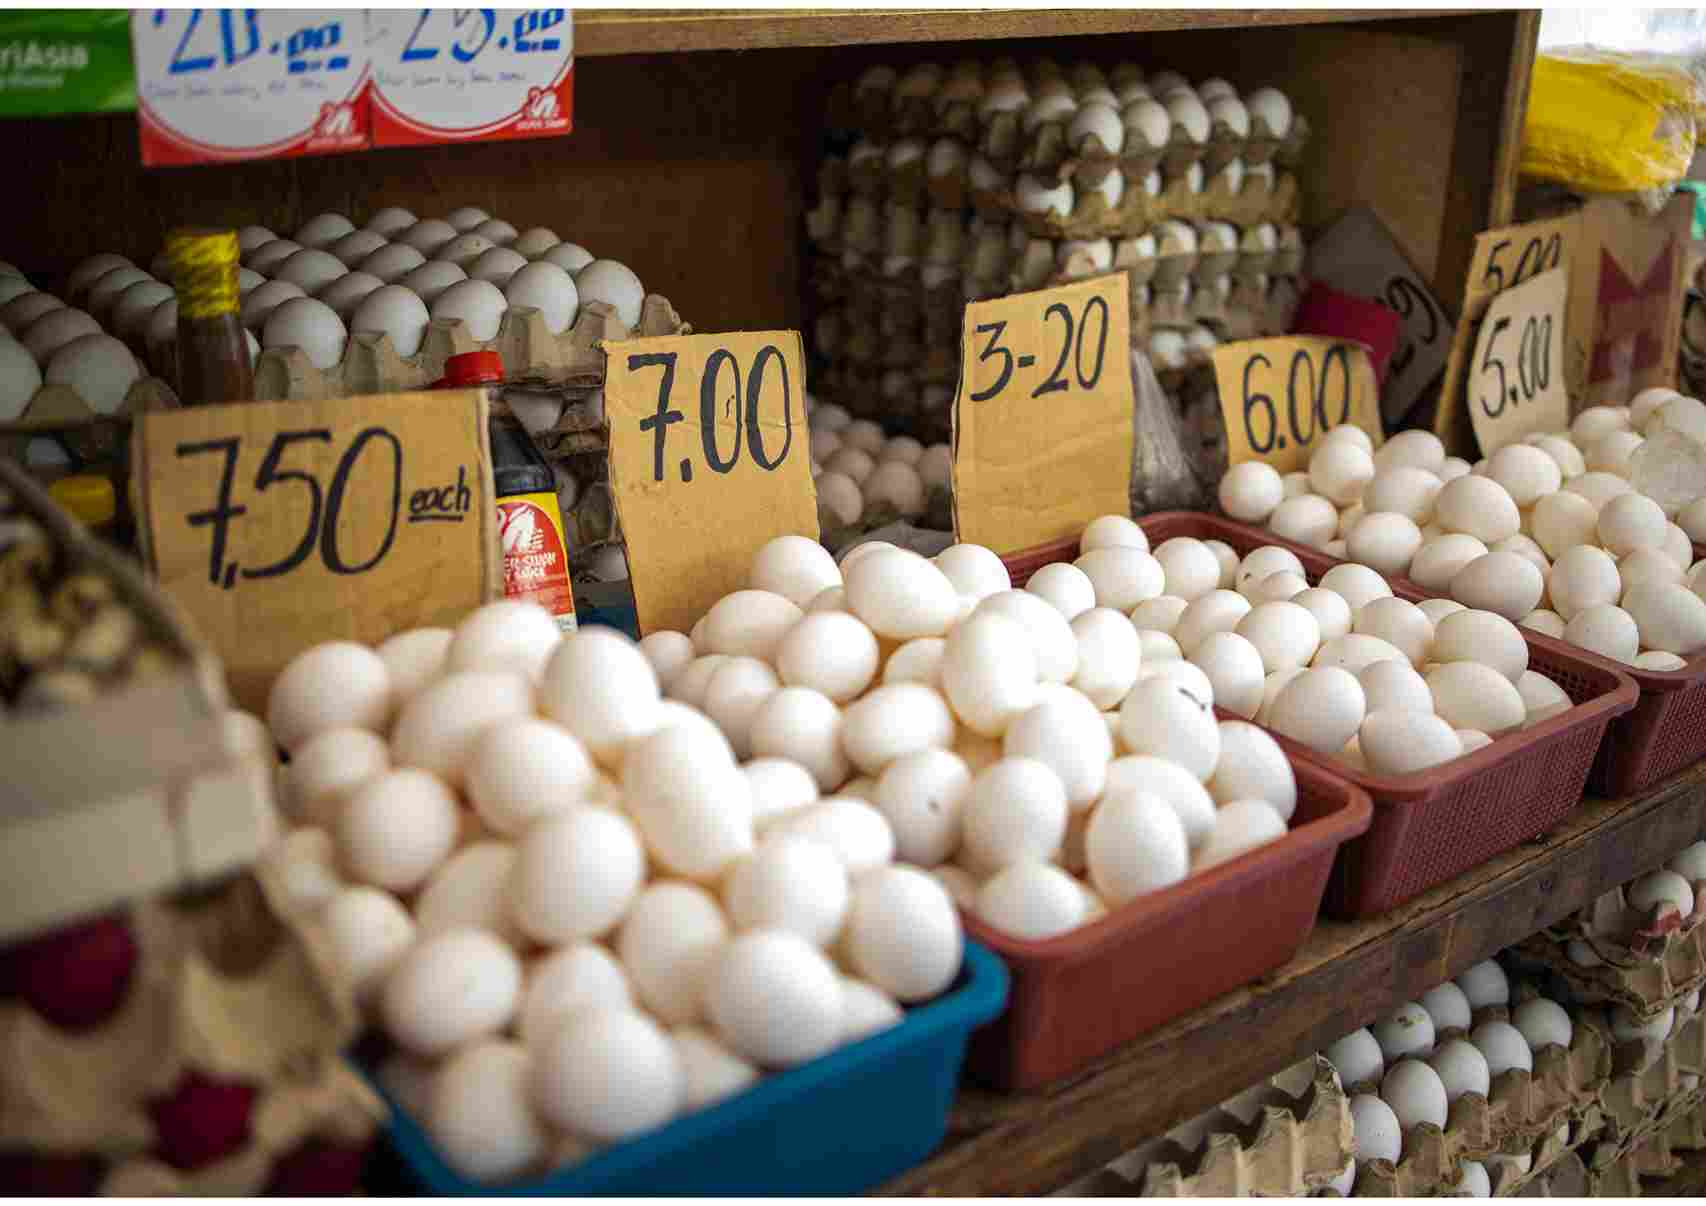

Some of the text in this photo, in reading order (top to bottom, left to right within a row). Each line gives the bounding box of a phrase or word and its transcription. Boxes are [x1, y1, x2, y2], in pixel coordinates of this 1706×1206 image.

[969, 295, 1109, 401] 3-20
[1242, 345, 1351, 454] 6.00
[1479, 314, 1552, 418] 5.00
[627, 345, 792, 482] 7.00
[407, 464, 472, 522] each
